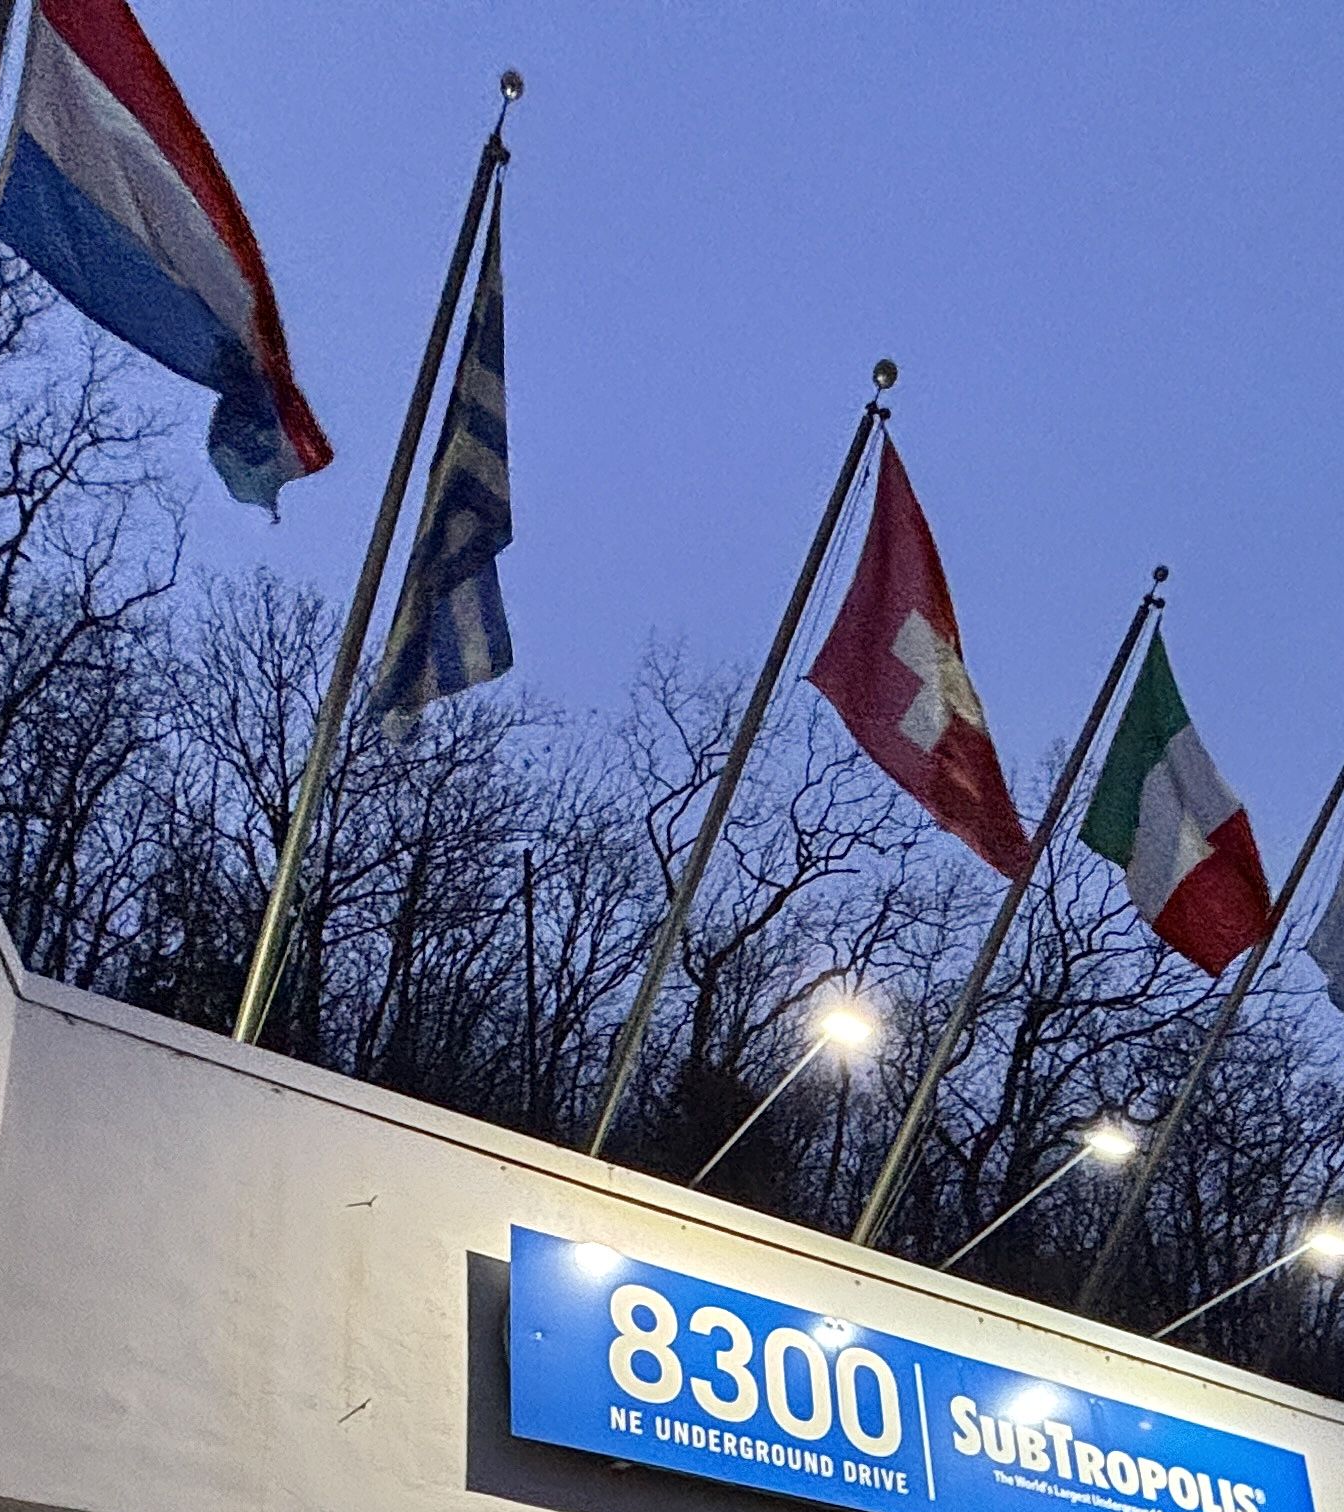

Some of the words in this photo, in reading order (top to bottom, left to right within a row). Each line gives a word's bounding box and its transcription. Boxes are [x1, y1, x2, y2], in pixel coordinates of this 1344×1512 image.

[609, 1284, 902, 1457] 8300
[610, 1406, 644, 1435] NE
[655, 1416, 834, 1478] UNDERGROUND
[843, 1460, 910, 1495] DRIVE
